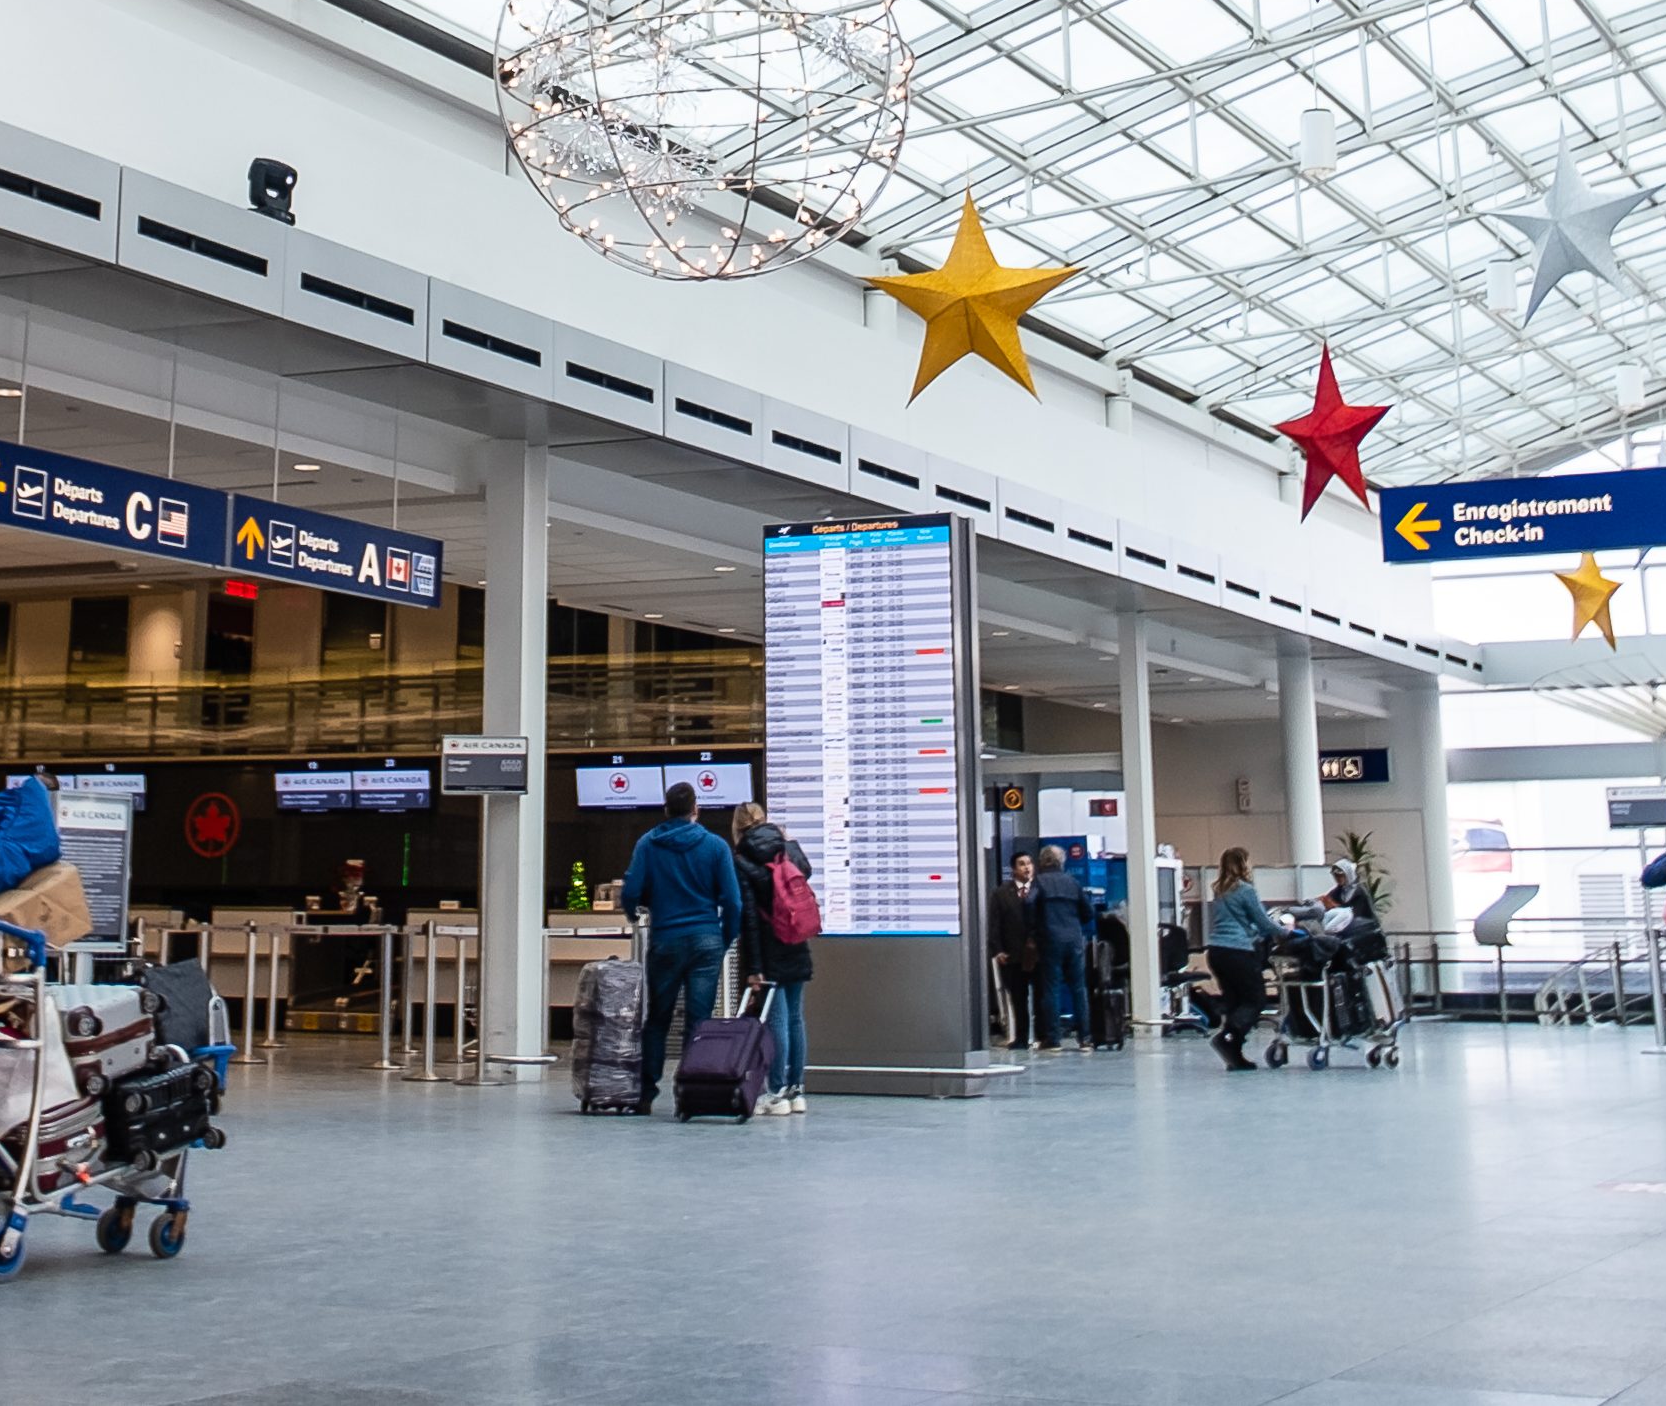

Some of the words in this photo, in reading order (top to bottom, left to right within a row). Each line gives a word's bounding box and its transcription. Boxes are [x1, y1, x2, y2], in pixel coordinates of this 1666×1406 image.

[54, 477, 104, 503] Départs
[52, 500, 120, 531] Departures
[126, 491, 152, 540] C
[1452, 492, 1613, 524] Enregistrement
[298, 530, 339, 553] Départs
[1454, 521, 1545, 547] Check-in
[297, 551, 354, 577] Departures
[357, 543, 381, 586] A
